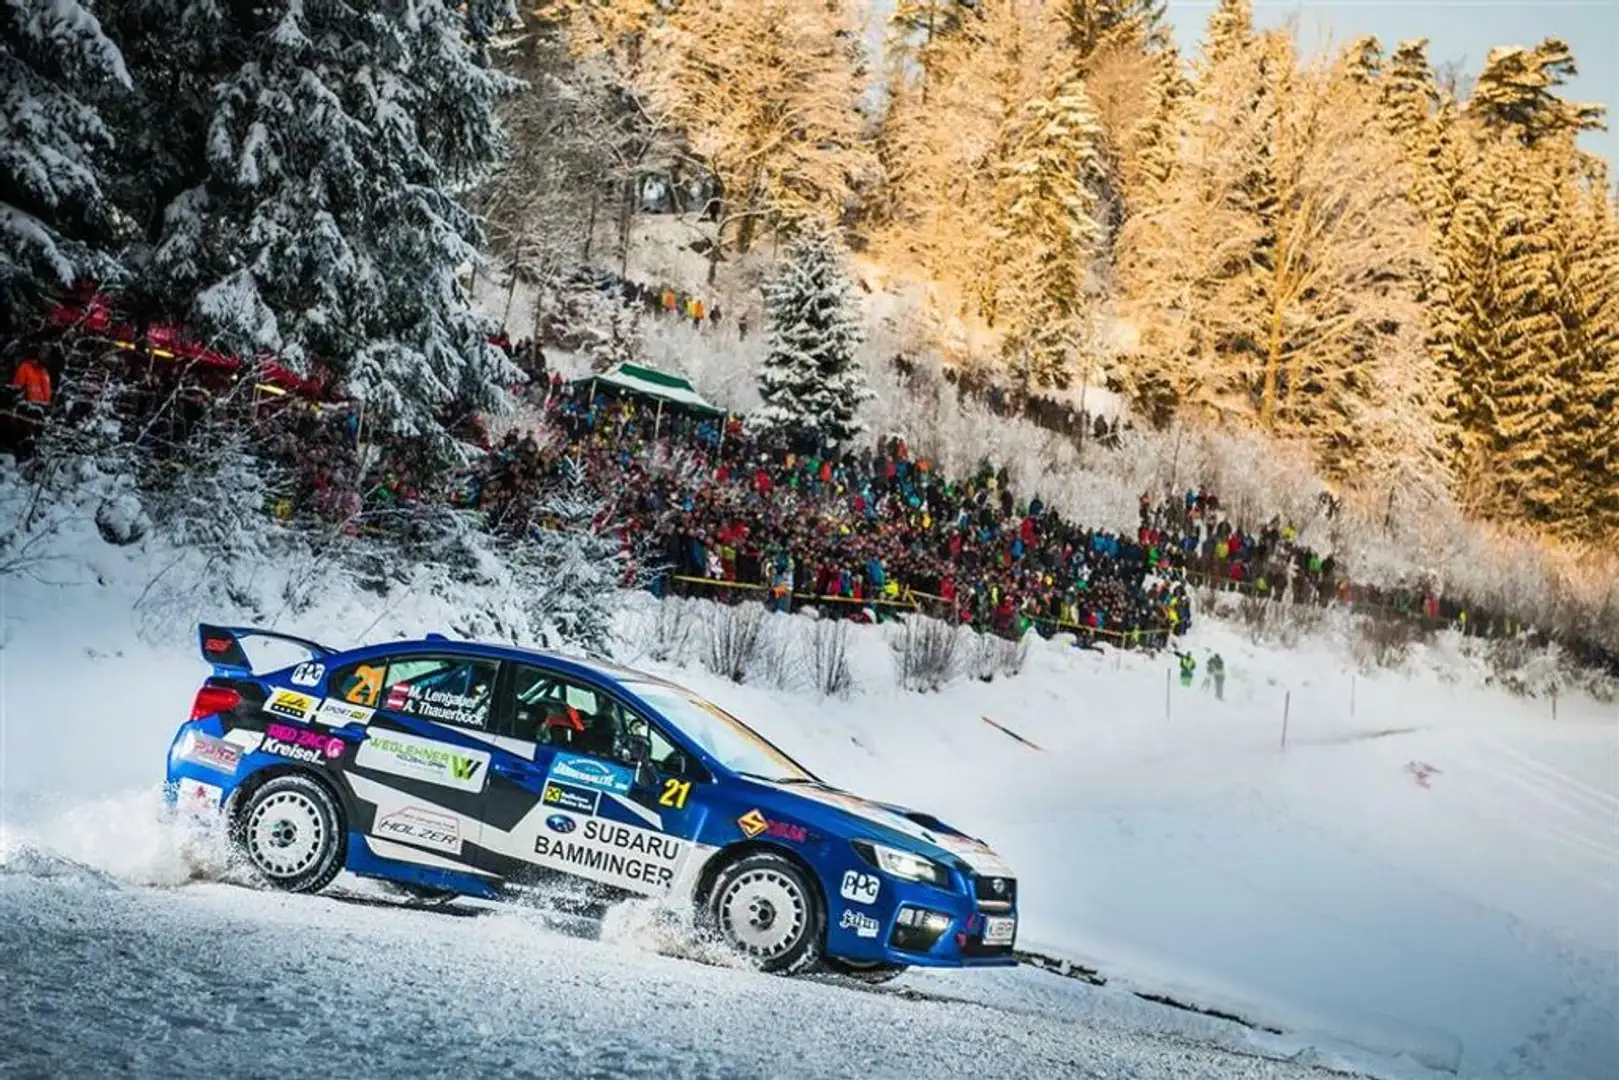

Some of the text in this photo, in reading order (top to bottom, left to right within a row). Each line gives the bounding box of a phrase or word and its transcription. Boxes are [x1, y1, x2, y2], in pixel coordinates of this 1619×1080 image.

[345, 664, 387, 707] 21
[658, 778, 691, 809] 21
[381, 820, 457, 844] HOLZER
[584, 820, 679, 861] SUBARU
[534, 835, 674, 888] BAMMINGER
[844, 873, 878, 897] PPG
